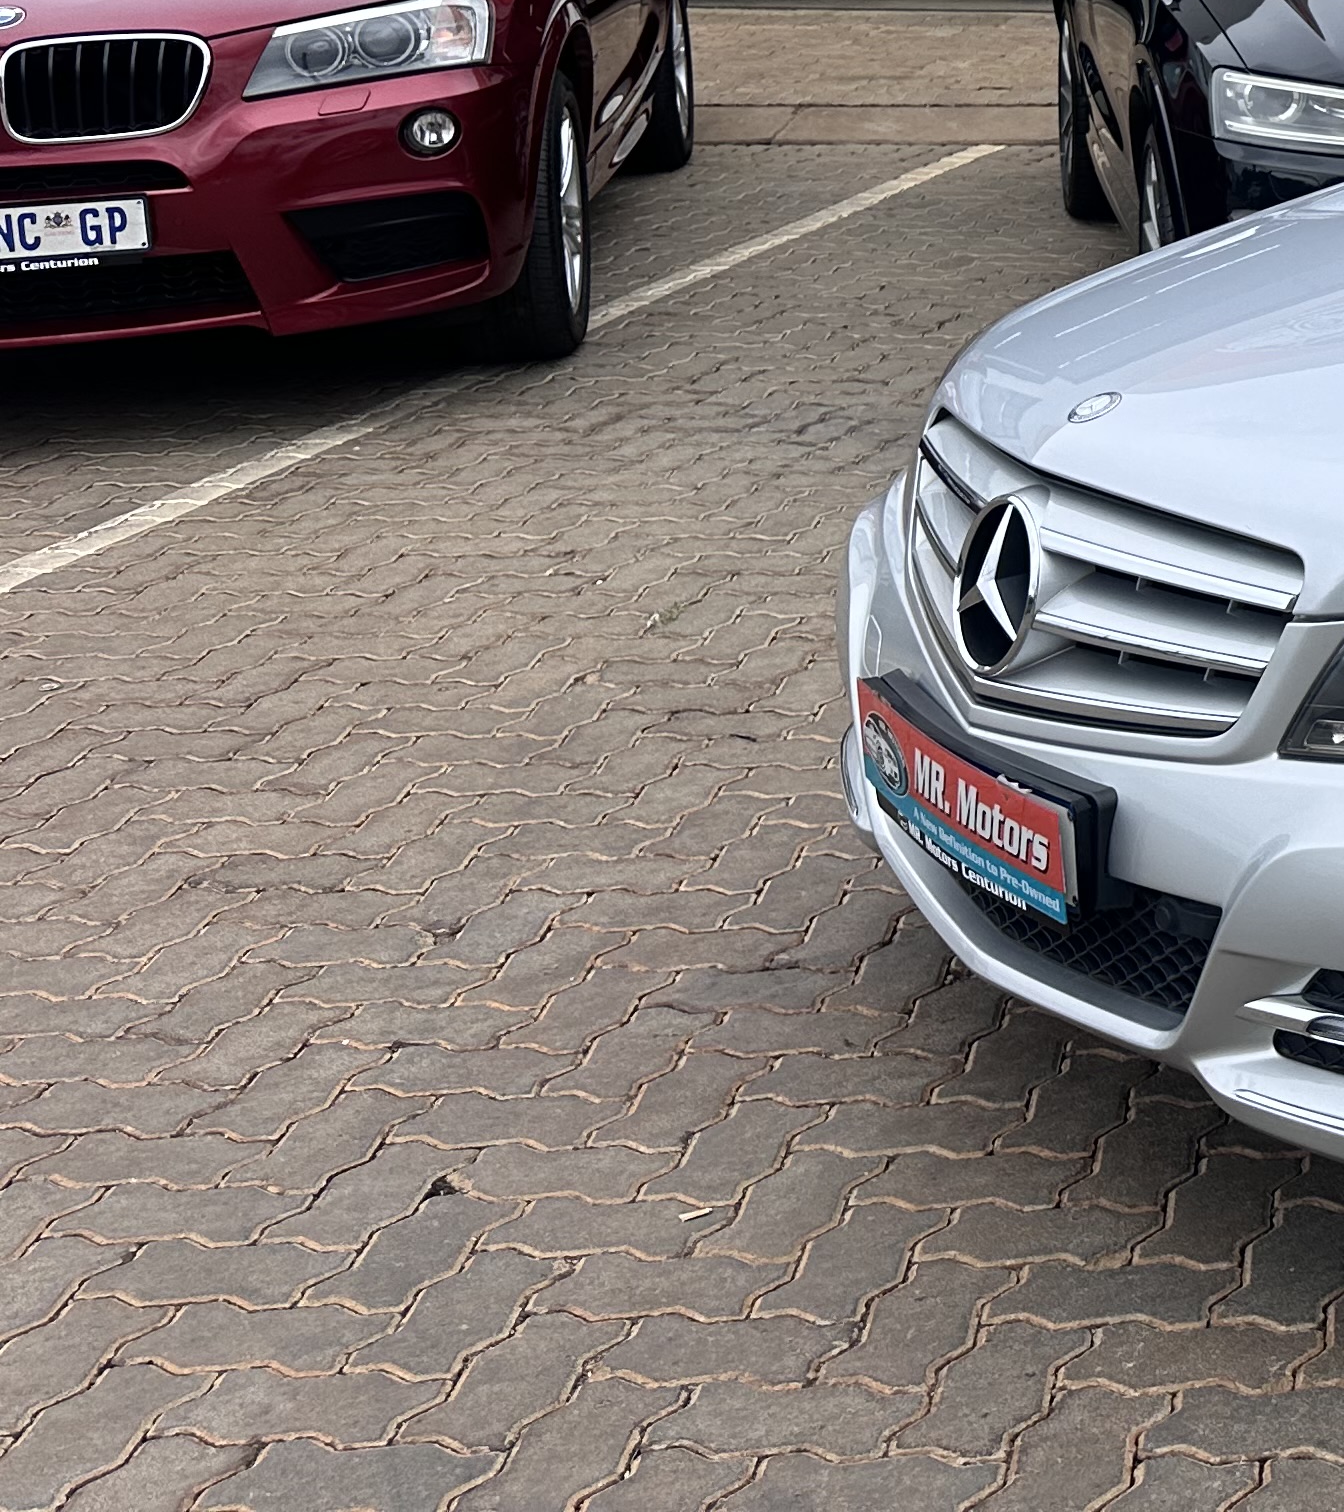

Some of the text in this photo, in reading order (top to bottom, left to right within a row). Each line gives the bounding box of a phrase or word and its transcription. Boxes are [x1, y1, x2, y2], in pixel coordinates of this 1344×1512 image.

[0, 206, 128, 252] NC GP
[21, 257, 99, 271] Centurion
[914, 747, 1049, 871] MR. Motors
[925, 834, 959, 872] Motors
[961, 862, 1027, 911] Centurion
[938, 826, 985, 868] Definition
[986, 859, 999, 876] to
[1000, 866, 1061, 912] Pre-Owned
